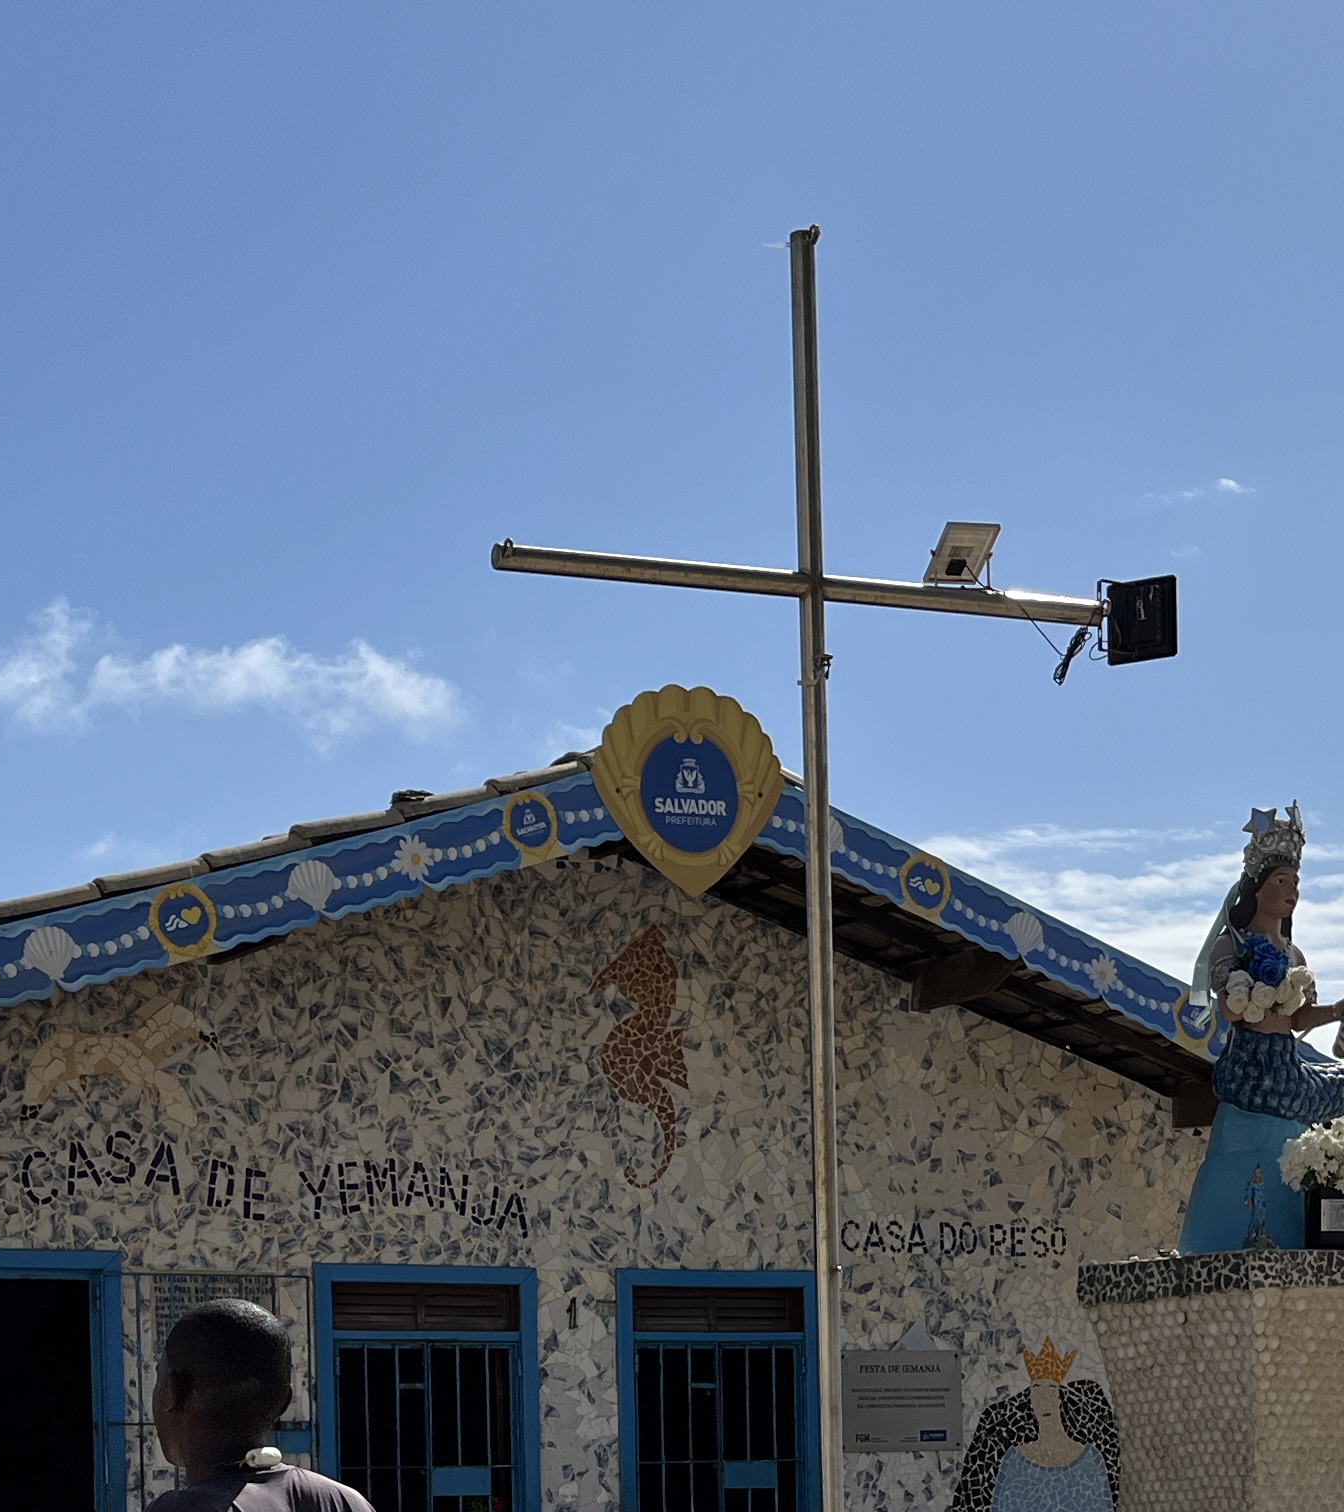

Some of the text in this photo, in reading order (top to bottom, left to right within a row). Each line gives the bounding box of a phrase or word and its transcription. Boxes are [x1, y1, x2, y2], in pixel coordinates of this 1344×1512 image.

[654, 797, 727, 816] SALVADOR
[665, 815, 718, 827] PREFEITURA
[21, 1130, 181, 1205] CASA
[207, 1159, 267, 1220] DE
[841, 1220, 928, 1254] CASA
[939, 1222, 978, 1254] DO
[859, 1365, 887, 1374] FESTA
[888, 1365, 901, 1373] DE
